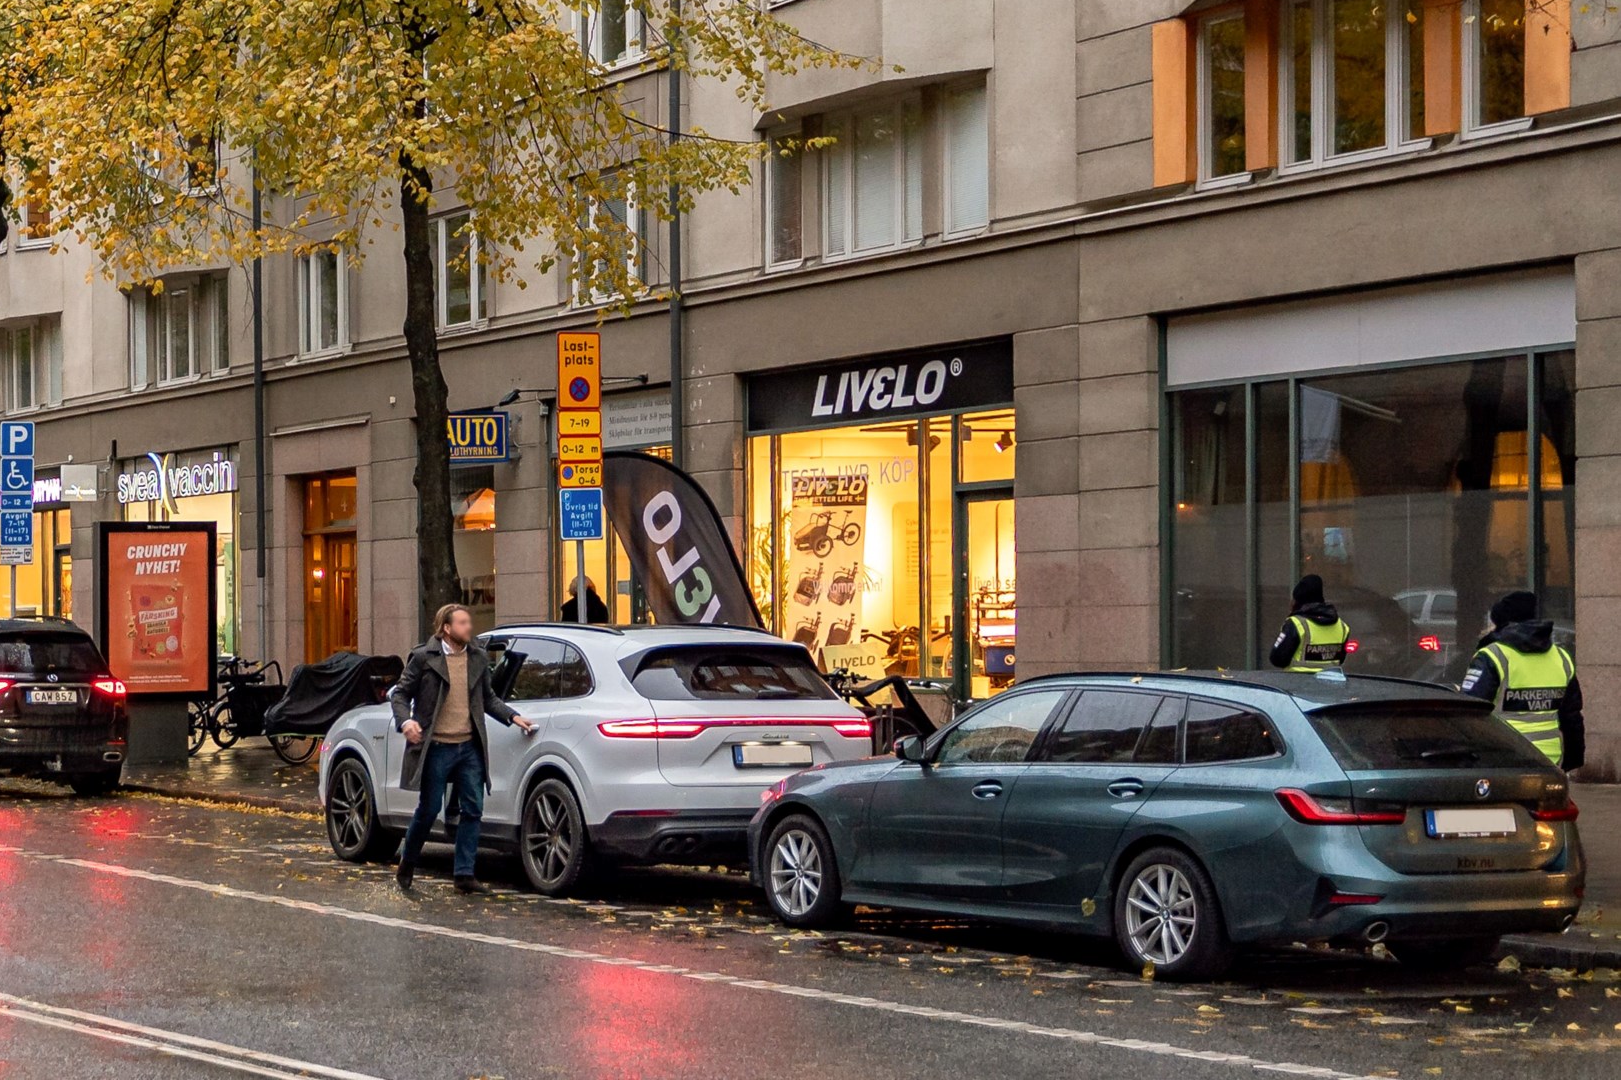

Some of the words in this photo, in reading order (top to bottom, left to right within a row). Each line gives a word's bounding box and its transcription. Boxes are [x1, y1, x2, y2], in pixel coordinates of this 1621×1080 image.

[564, 340, 594, 351] Last-
[564, 354, 594, 366] plats
[569, 418, 590, 428] 7-19
[450, 445, 498, 457] LUTHYRNING
[562, 444, 584, 454] 0-12
[574, 465, 599, 474] Torsd
[118, 469, 159, 503] svea
[169, 451, 232, 498] vaccin
[579, 476, 596, 485] 0-6
[570, 512, 593, 520] Avgift
[127, 543, 187, 559] CRUNCHY
[135, 560, 181, 575] NYHET!
[832, 655, 875, 669] LIVELO
[34, 690, 53, 702] CAW
[55, 690, 74, 702] 85Z
[1527, 699, 1552, 711] VAKT
